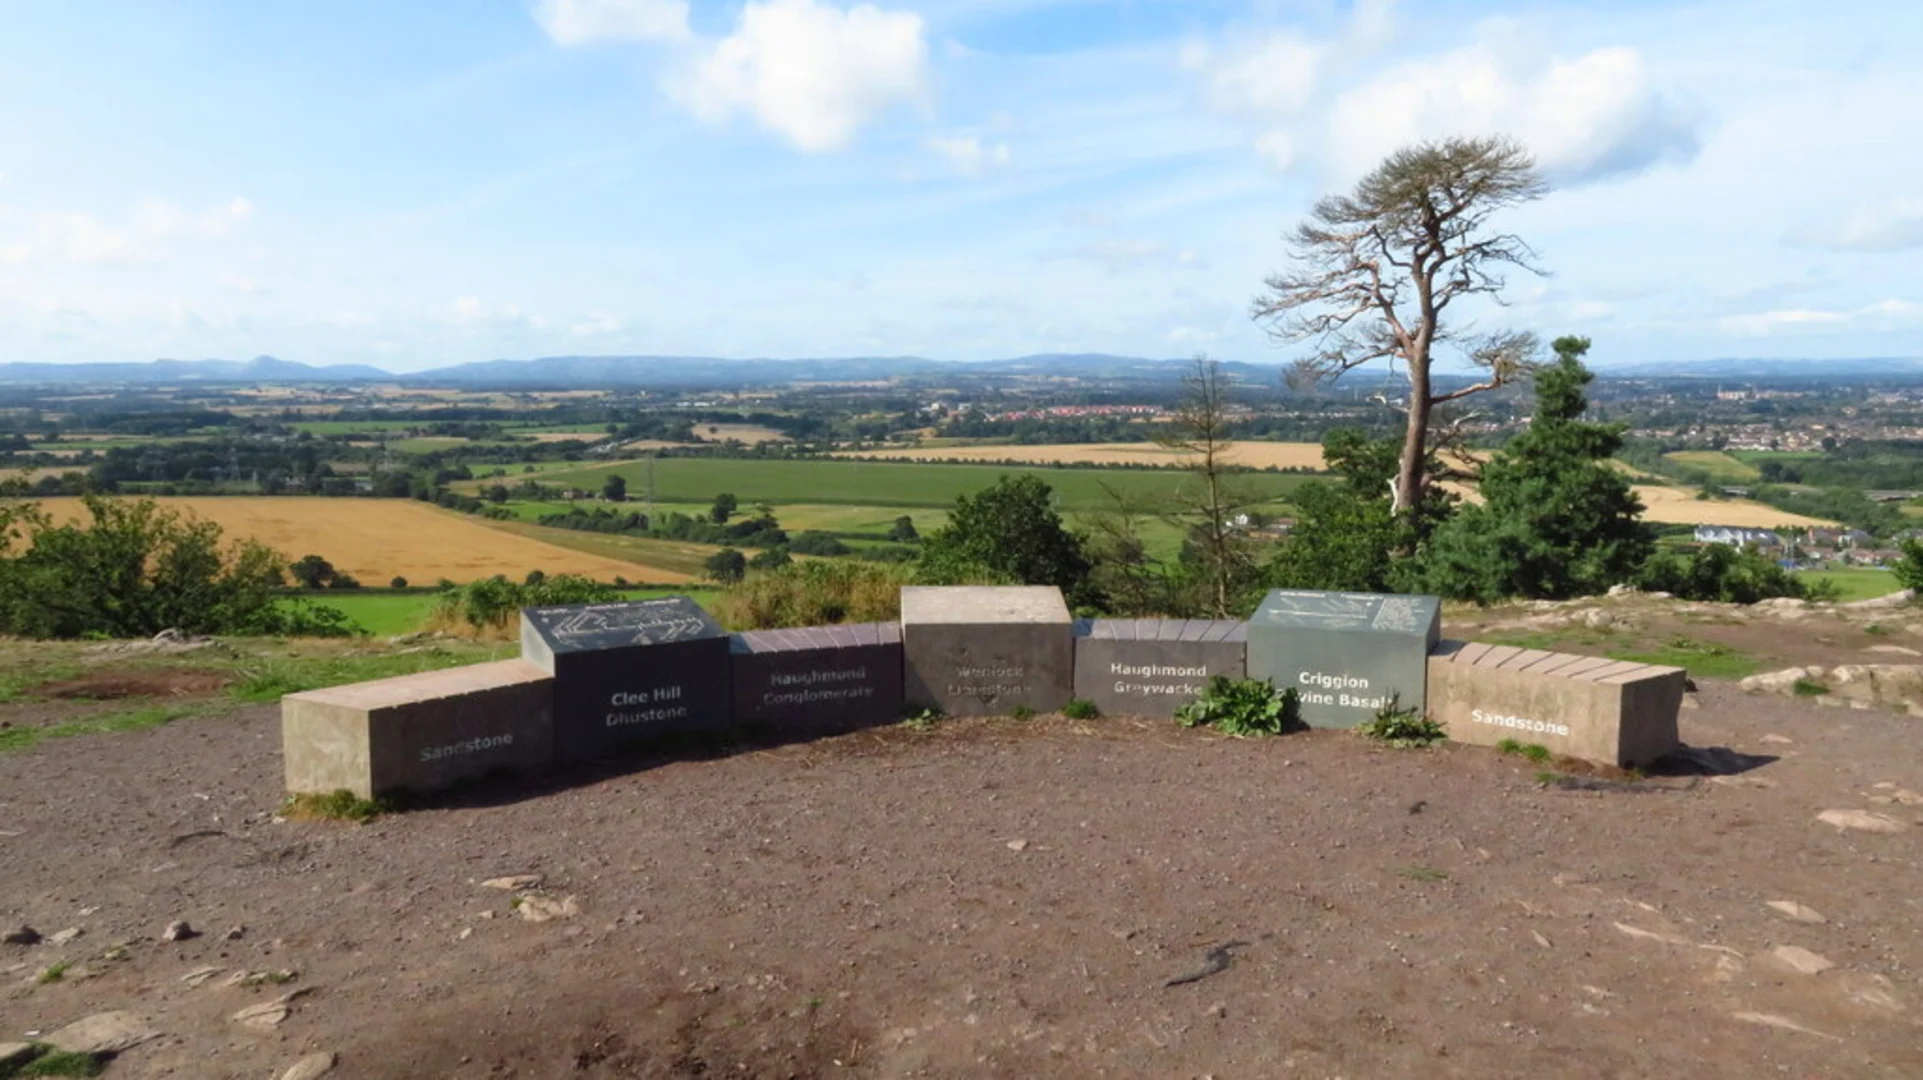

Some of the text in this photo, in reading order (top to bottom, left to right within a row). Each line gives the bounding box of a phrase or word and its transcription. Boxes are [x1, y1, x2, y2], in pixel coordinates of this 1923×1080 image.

[1110, 662, 1207, 678] Haughmond
[1299, 671, 1369, 689] Criggion
[611, 685, 681, 706] Clee Hill
[1471, 709, 1569, 736] Sandstone
[420, 733, 513, 762] Sandstone
